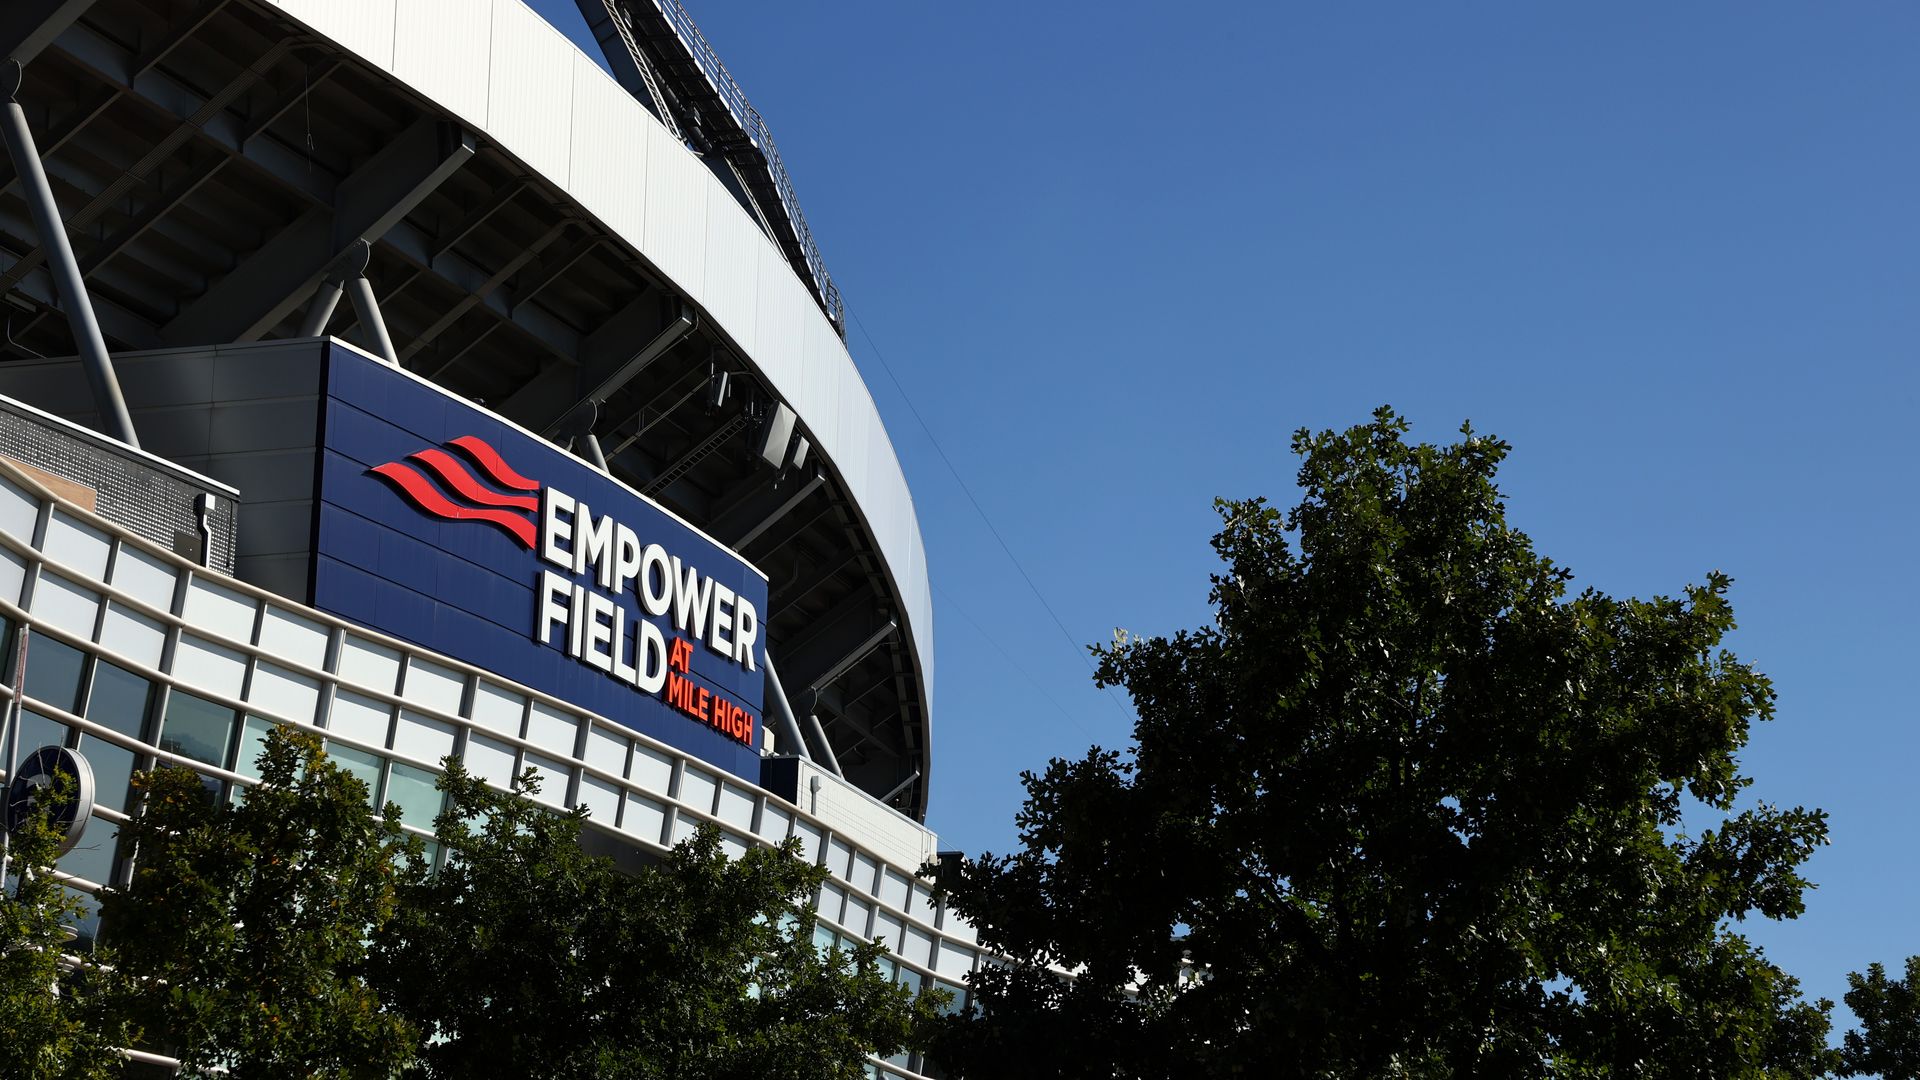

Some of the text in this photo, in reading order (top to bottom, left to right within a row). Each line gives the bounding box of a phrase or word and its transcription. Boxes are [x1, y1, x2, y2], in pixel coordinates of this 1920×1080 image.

[542, 486, 758, 672] EMPOWER
[537, 569, 668, 694] FIELD
[670, 636, 694, 674] AT
[666, 672, 754, 746] MILE HIGH
